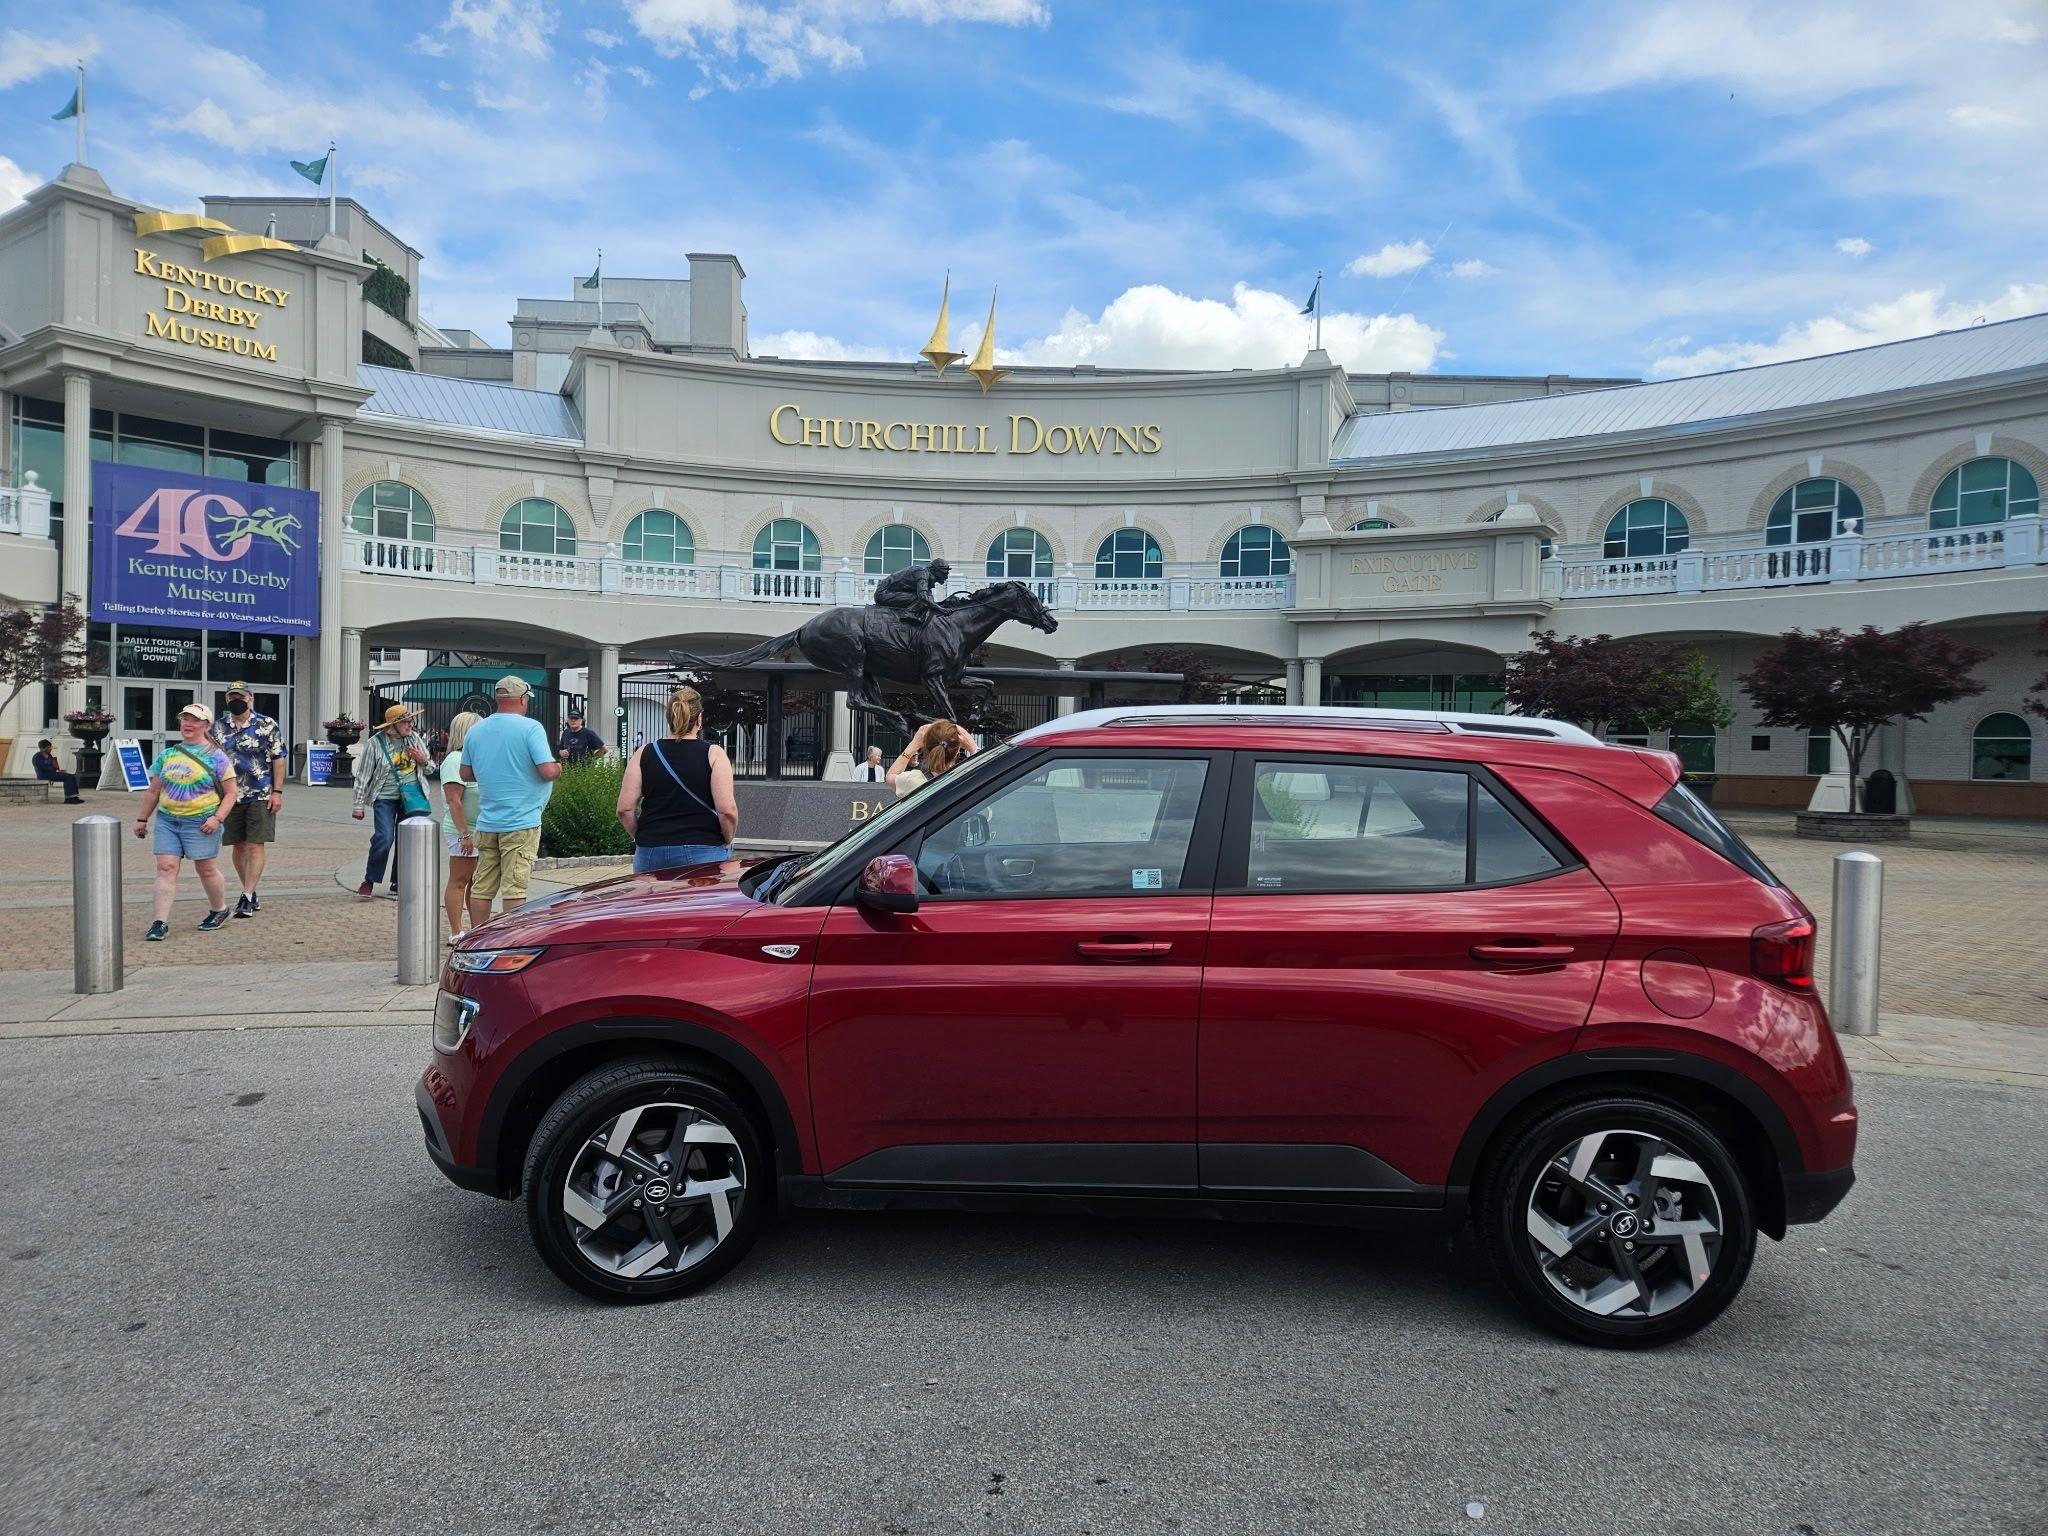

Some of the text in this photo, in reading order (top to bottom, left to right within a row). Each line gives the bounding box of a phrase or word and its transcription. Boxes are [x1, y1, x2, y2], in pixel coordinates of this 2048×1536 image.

[134, 248, 291, 307] KENTUCKY
[165, 286, 261, 329] DERBY
[146, 312, 278, 362] MUSEUM
[769, 404, 1162, 455] CHURCHILL DOWNS
[114, 488, 252, 561] 40
[128, 558, 291, 590] Kentucky Derby
[1350, 552, 1478, 574] EXECUTIVE
[167, 582, 256, 604] Museum
[1383, 575, 1441, 592] GATE
[102, 602, 311, 627] Telling Derby Stories for 40 Years and Counting
[123, 637, 195, 648] DAILY TOURS OF
[133, 645, 185, 655] CHURCHILL
[142, 654, 177, 663] DOWNS
[218, 651, 247, 660] STORE
[248, 652, 254, 660] &
